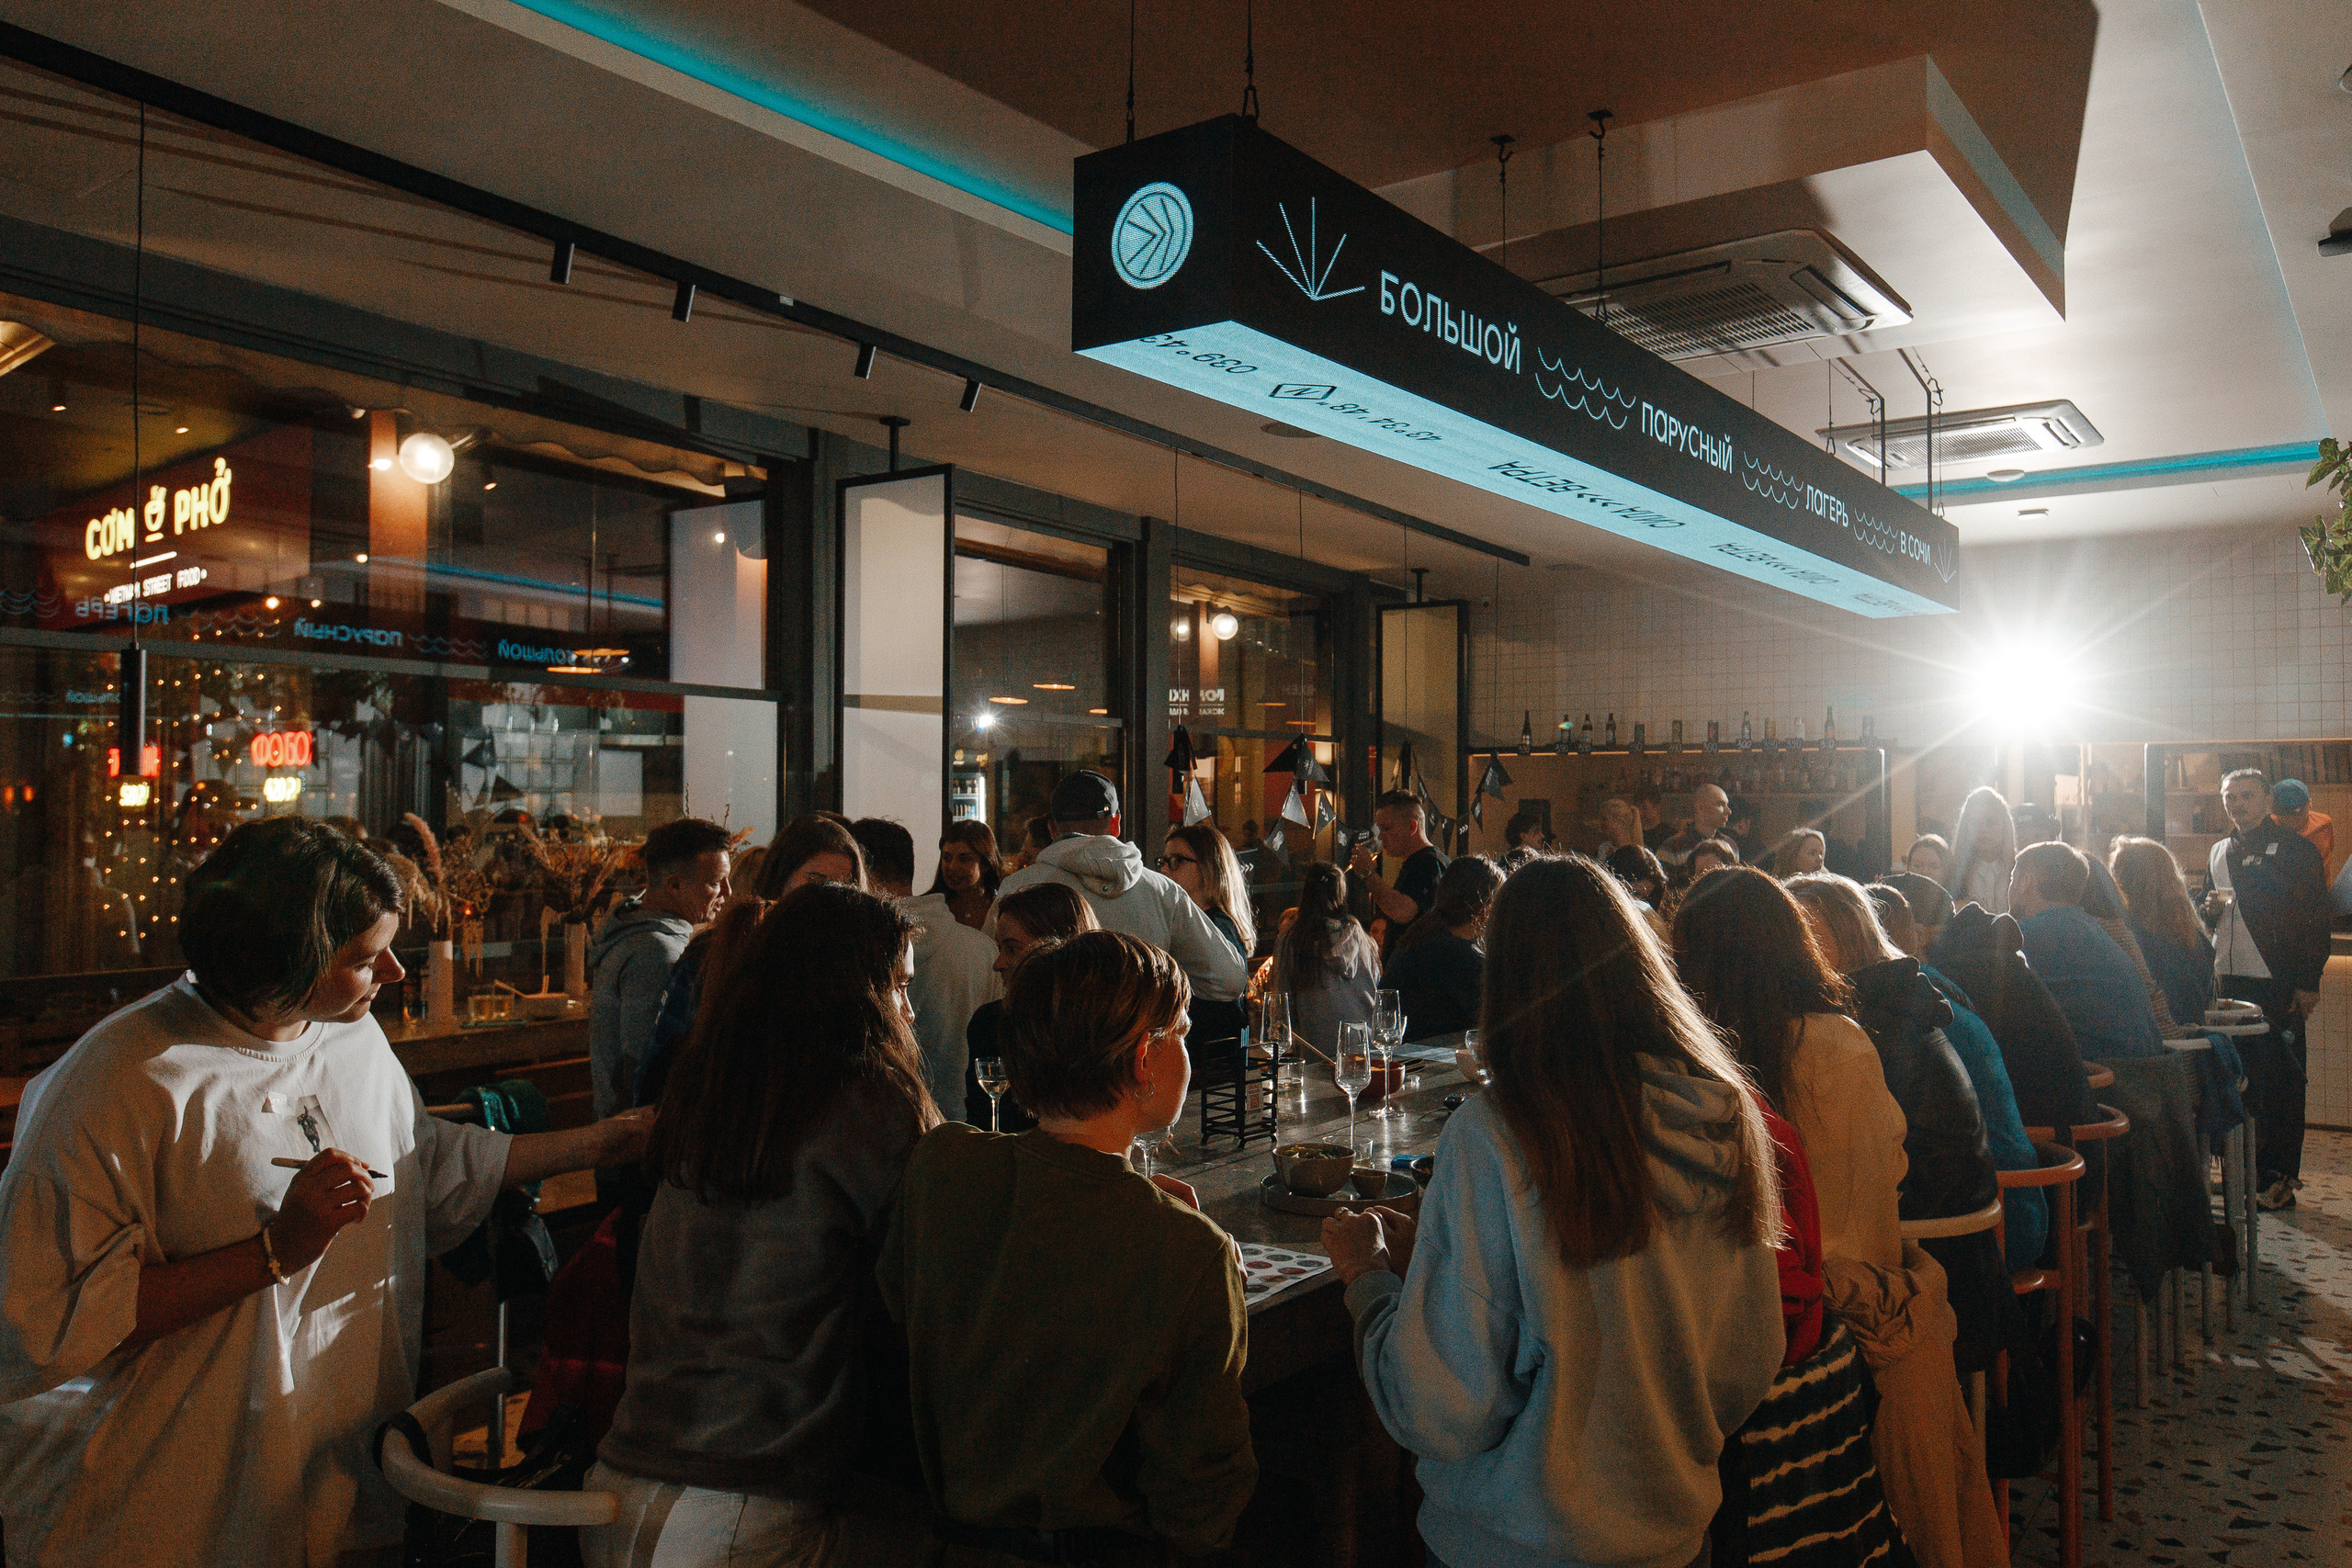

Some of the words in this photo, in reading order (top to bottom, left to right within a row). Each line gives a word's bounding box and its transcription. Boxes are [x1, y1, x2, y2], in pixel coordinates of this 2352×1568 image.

[1380, 269, 1521, 375] БОЛЬШОЙ
[1642, 400, 1733, 475] ПАРУСНЫЙ
[1805, 484, 1849, 528] ЛАГЕРЬ
[1907, 534, 1931, 566] СОЧИ
[1487, 460, 1589, 493] ВЕТРА
[142, 573, 173, 598] STREET
[176, 566, 201, 589] FOOD
